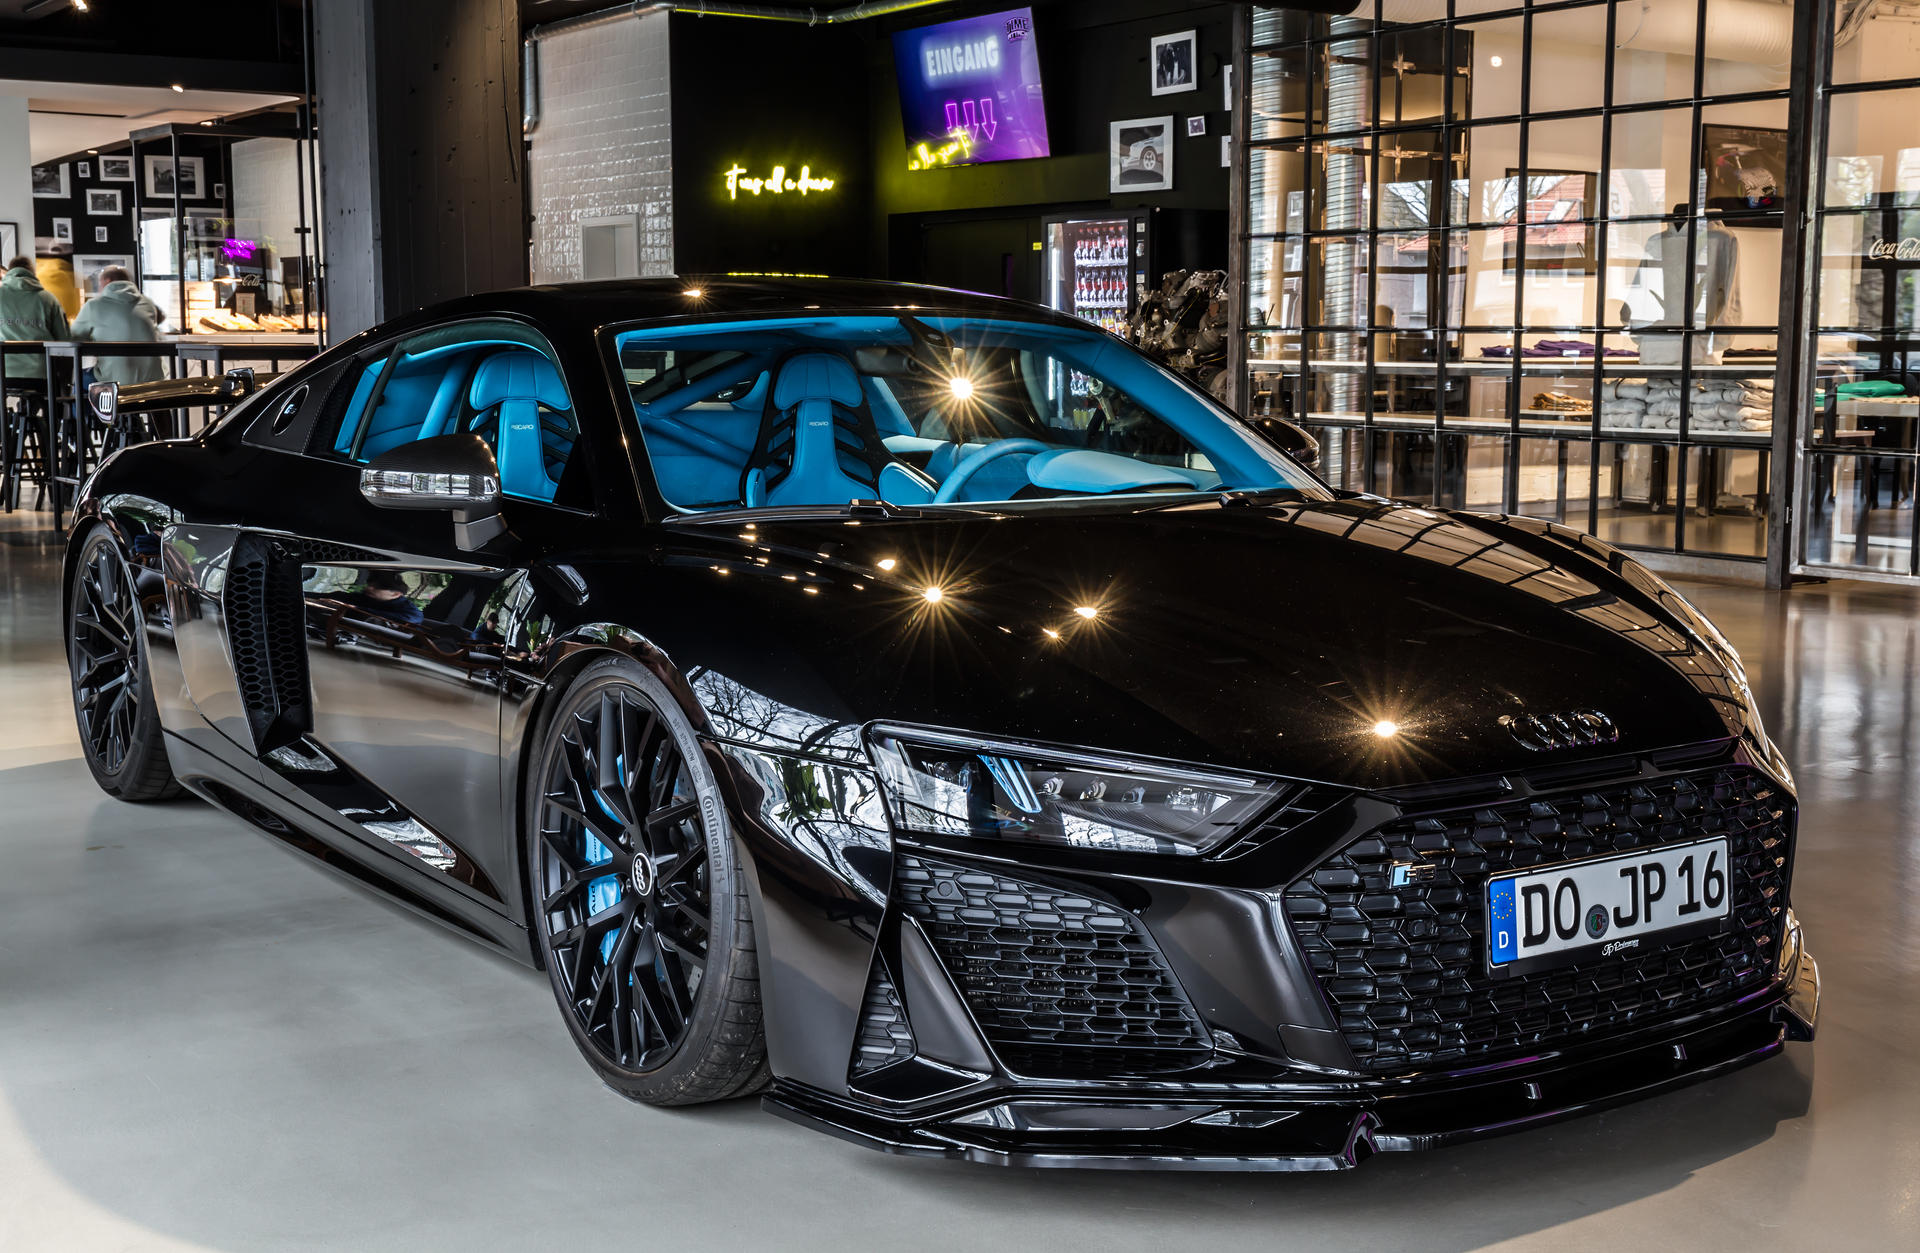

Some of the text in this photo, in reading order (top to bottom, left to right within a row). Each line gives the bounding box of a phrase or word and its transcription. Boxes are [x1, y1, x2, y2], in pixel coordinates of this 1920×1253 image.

[926, 35, 999, 77] EINGANG
[703, 795, 724, 872] Continental
[1521, 877, 1581, 948] DO
[1613, 862, 1667, 928] JP
[1678, 850, 1725, 916] 16
[1498, 931, 1509, 949] D
